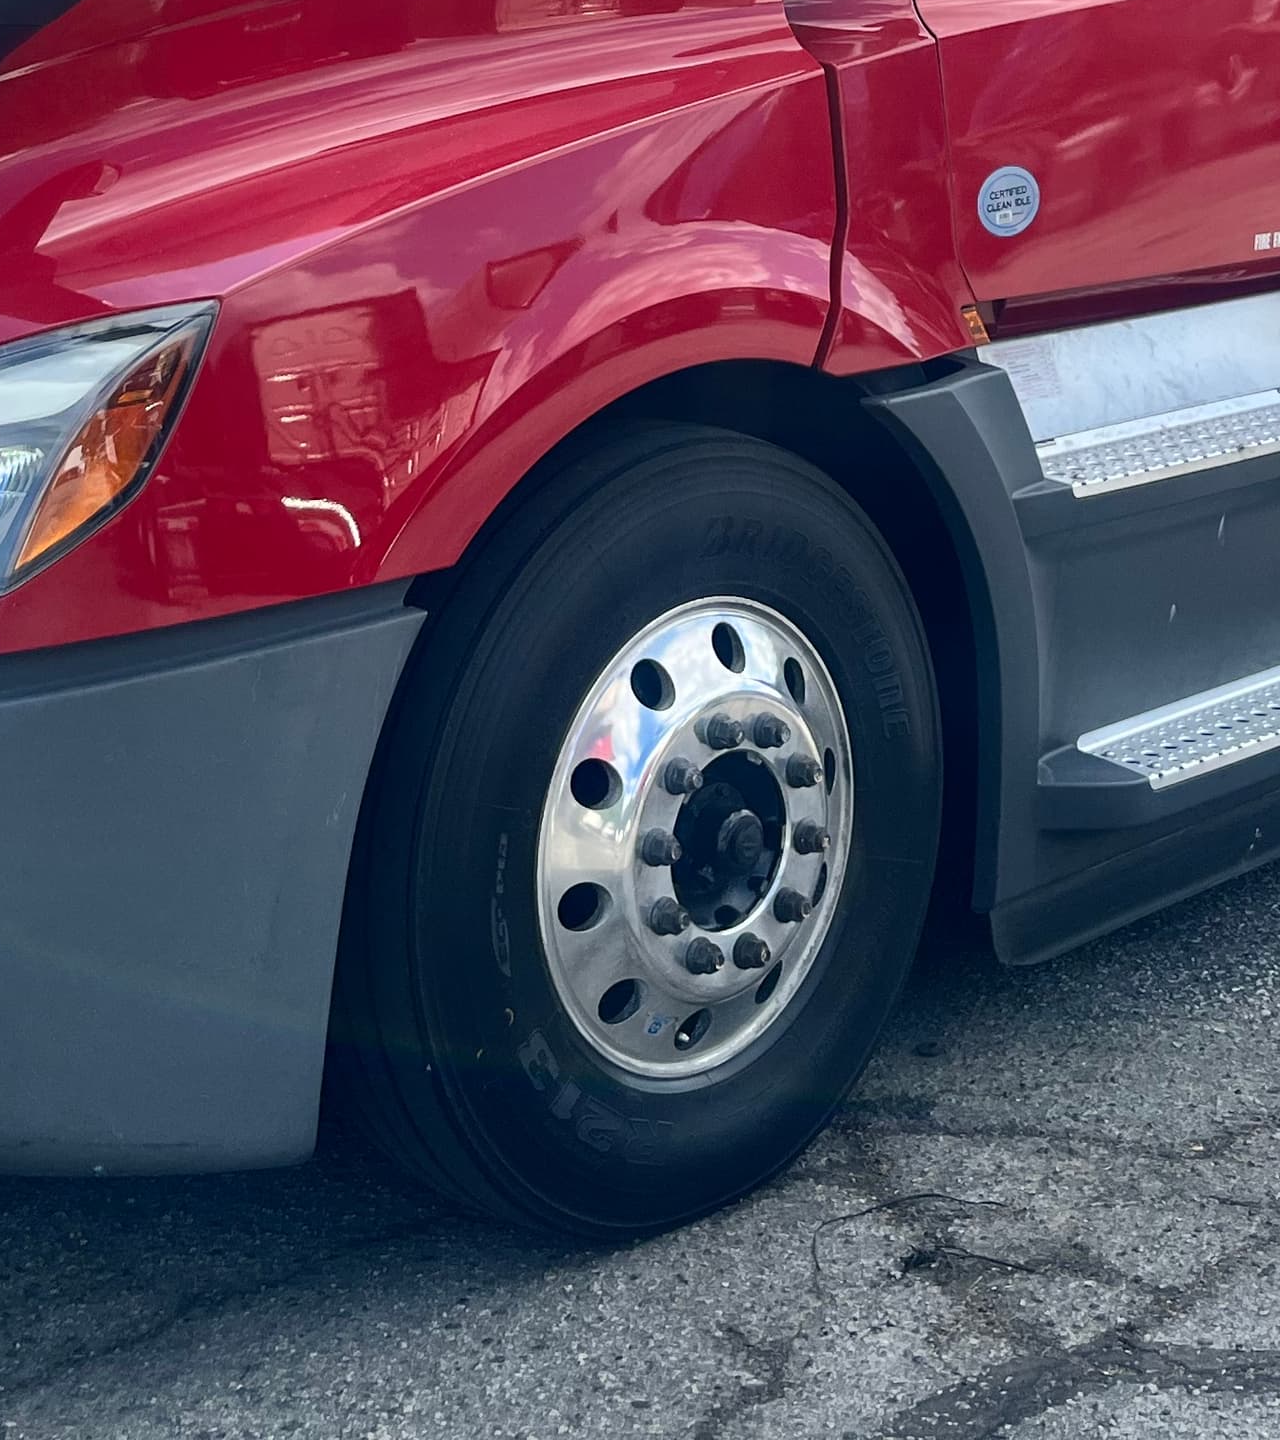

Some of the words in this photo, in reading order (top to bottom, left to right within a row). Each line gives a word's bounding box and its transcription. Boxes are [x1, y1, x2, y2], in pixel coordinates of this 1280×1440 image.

[990, 185, 1027, 200] CERTIFIED
[987, 200, 1013, 213] CLEAN
[1015, 196, 1031, 206] IDLE
